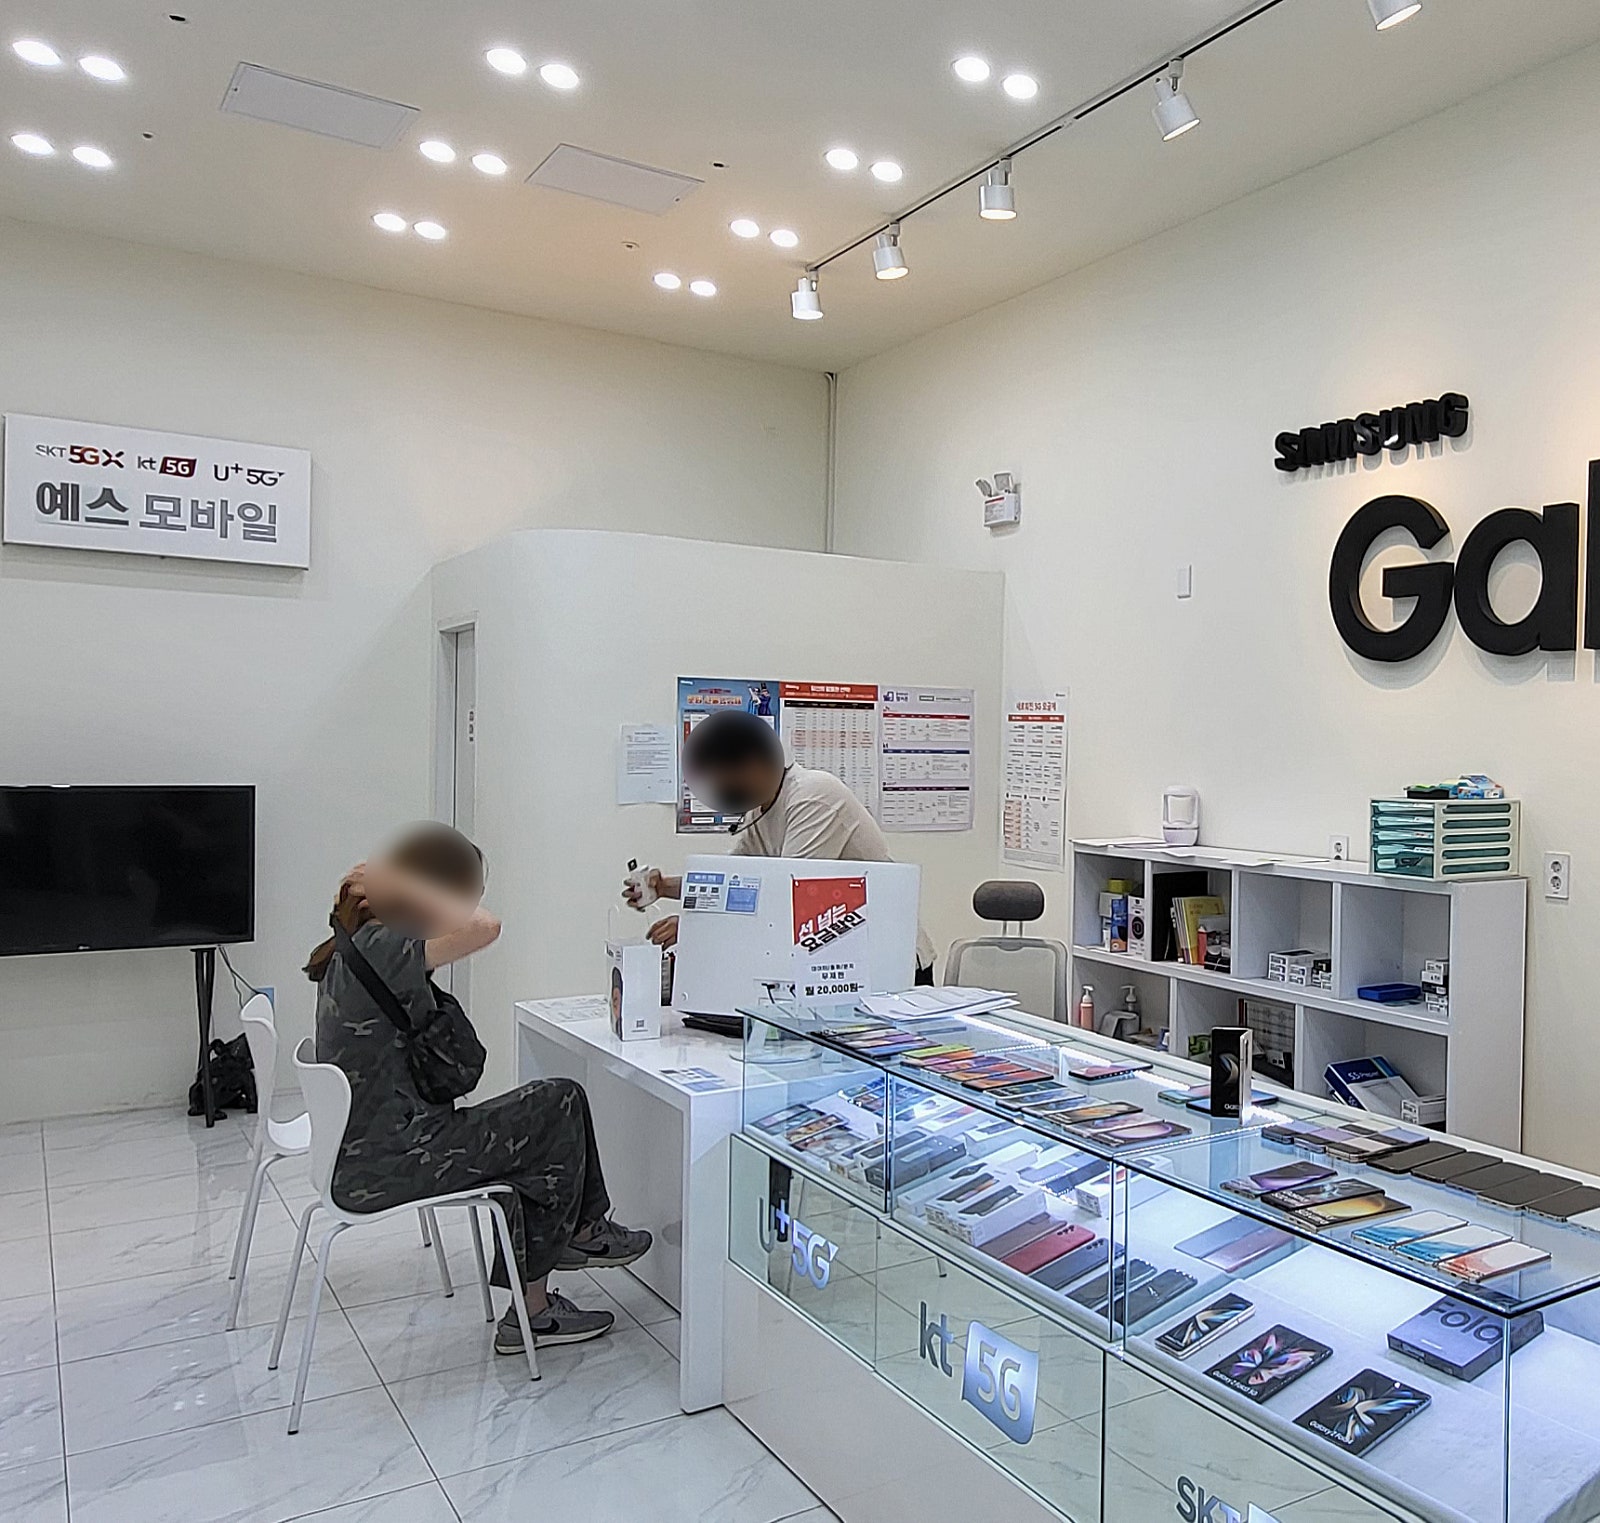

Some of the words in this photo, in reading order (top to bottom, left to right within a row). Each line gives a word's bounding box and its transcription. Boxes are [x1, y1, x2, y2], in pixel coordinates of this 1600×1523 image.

[35, 444, 66, 459] SKT
[1274, 392, 1469, 472] SAMSUNG
[137, 456, 157, 471] kt
[165, 459, 191, 476] 5G
[213, 463, 244, 482] U+
[246, 468, 285, 487] 5G
[36, 481, 130, 526] 예스
[139, 493, 278, 544] 모바일
[800, 911, 866, 954] 요금할인
[821, 971, 845, 980] 무제한
[758, 1196, 791, 1254] U+
[792, 1219, 839, 1291] 5G
[919, 1301, 954, 1378] kt
[977, 1340, 1022, 1421] 5G
